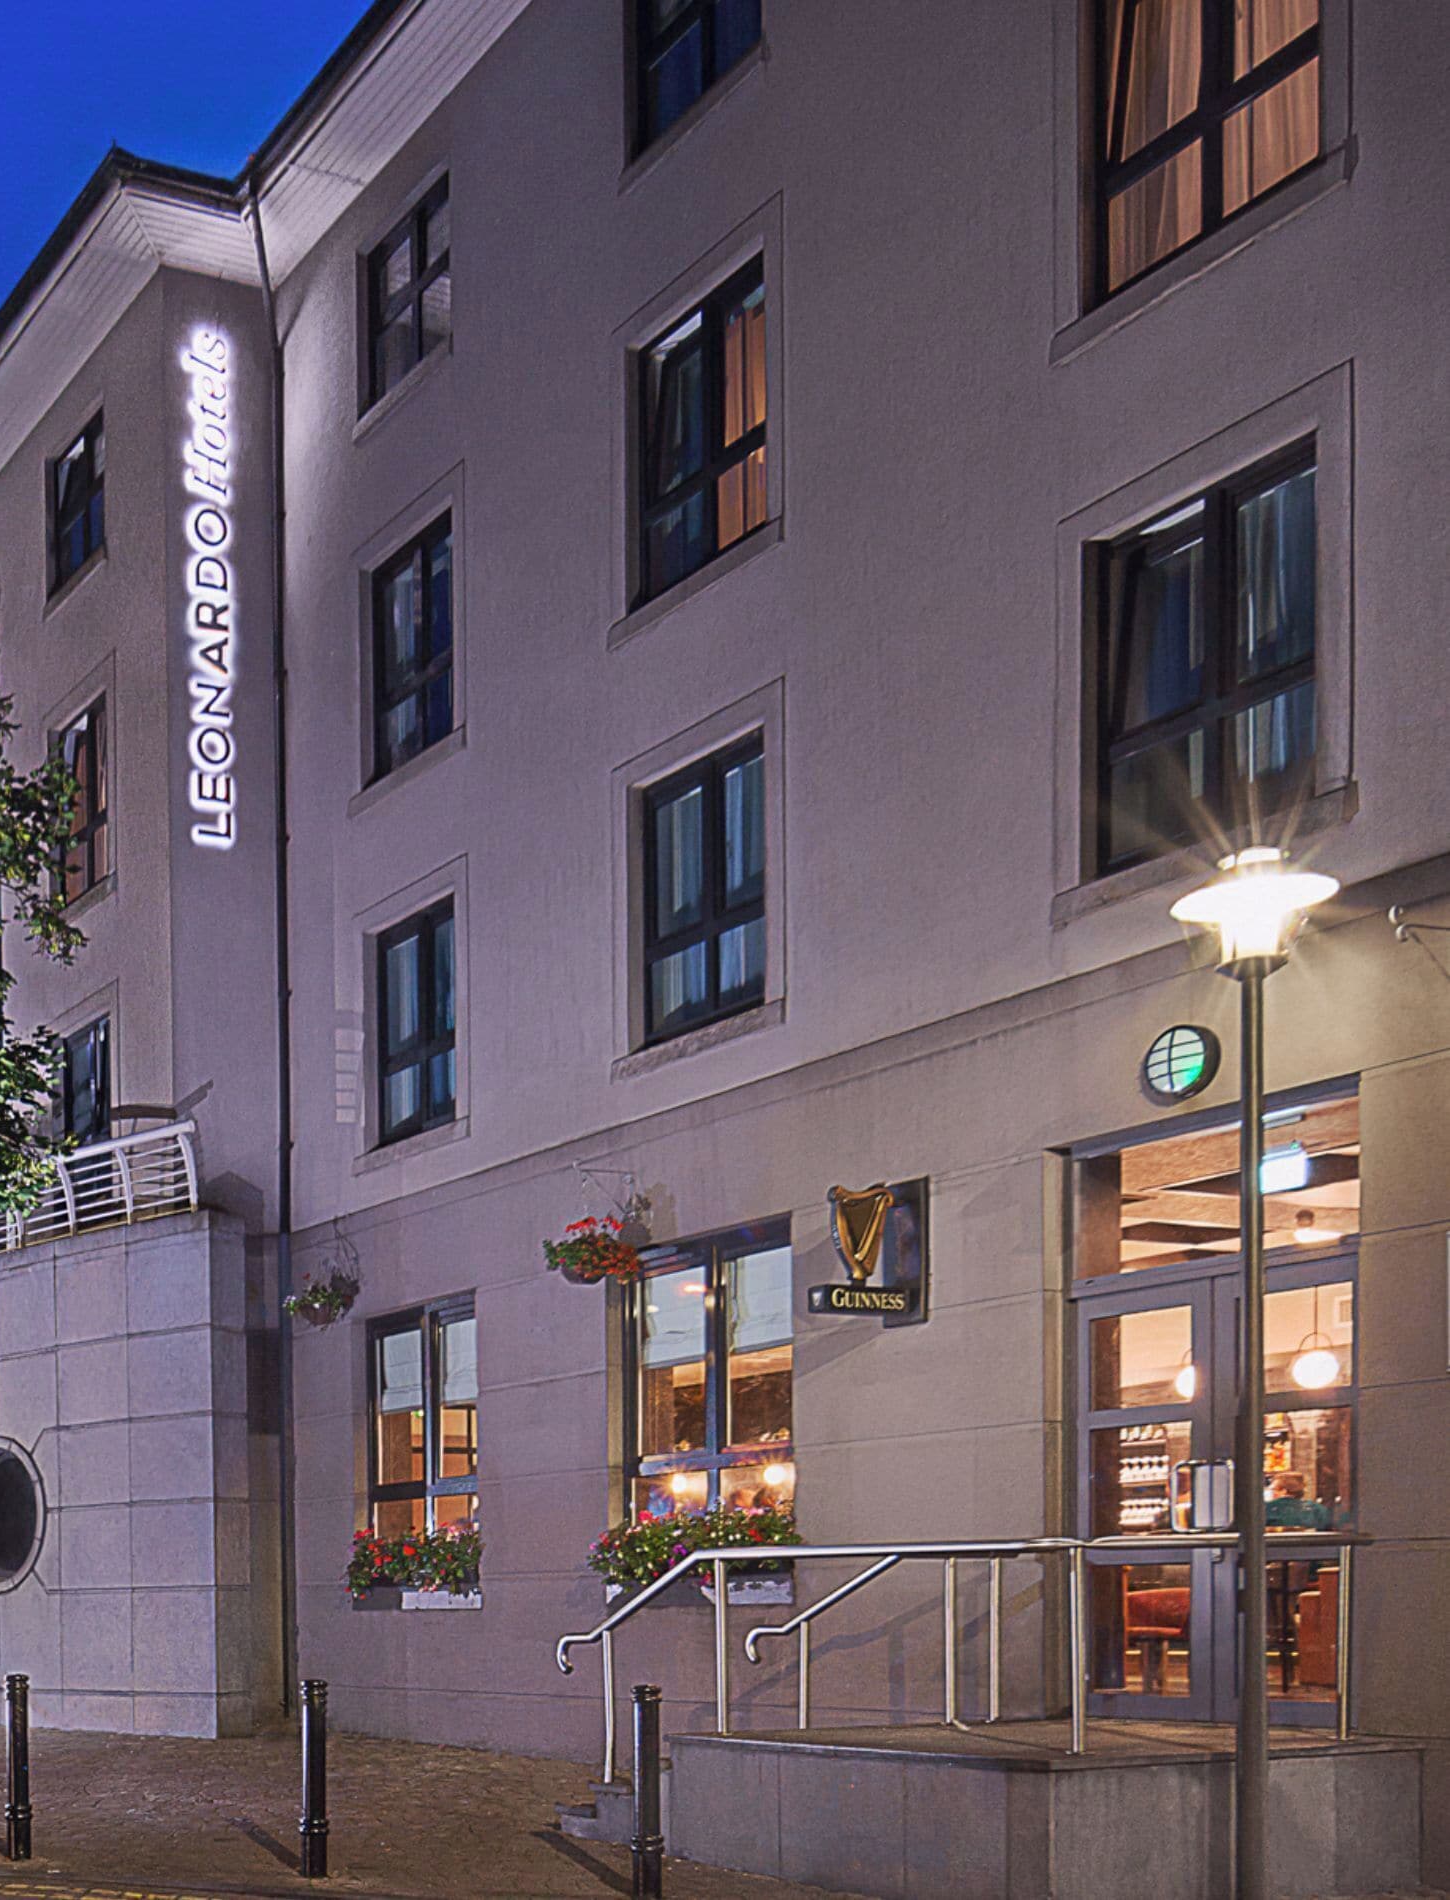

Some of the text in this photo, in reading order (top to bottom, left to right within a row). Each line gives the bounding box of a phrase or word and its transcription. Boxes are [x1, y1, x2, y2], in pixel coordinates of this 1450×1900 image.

[188, 329, 232, 839] LEONARDO Hotels
[831, 1287, 905, 1310] GUINNESS
